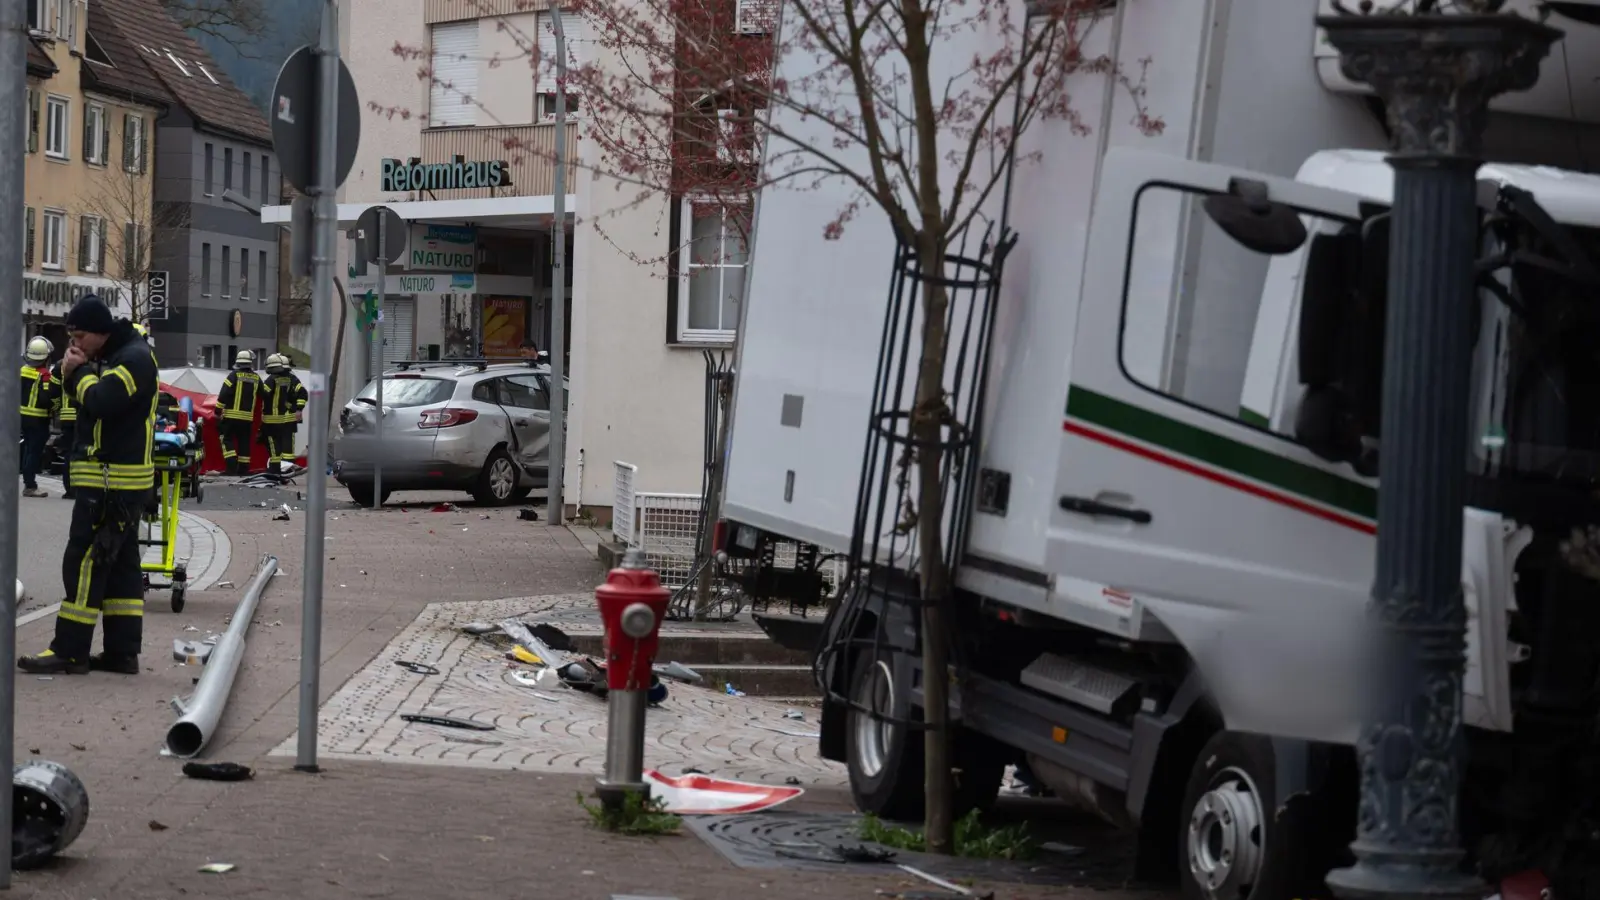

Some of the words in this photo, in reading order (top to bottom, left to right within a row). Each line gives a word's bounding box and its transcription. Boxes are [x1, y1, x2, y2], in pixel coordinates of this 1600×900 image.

[381, 154, 505, 191] Reformhaus
[413, 250, 473, 268] NATURO
[149, 277, 165, 312] TOTO
[399, 276, 435, 292] NATURO
